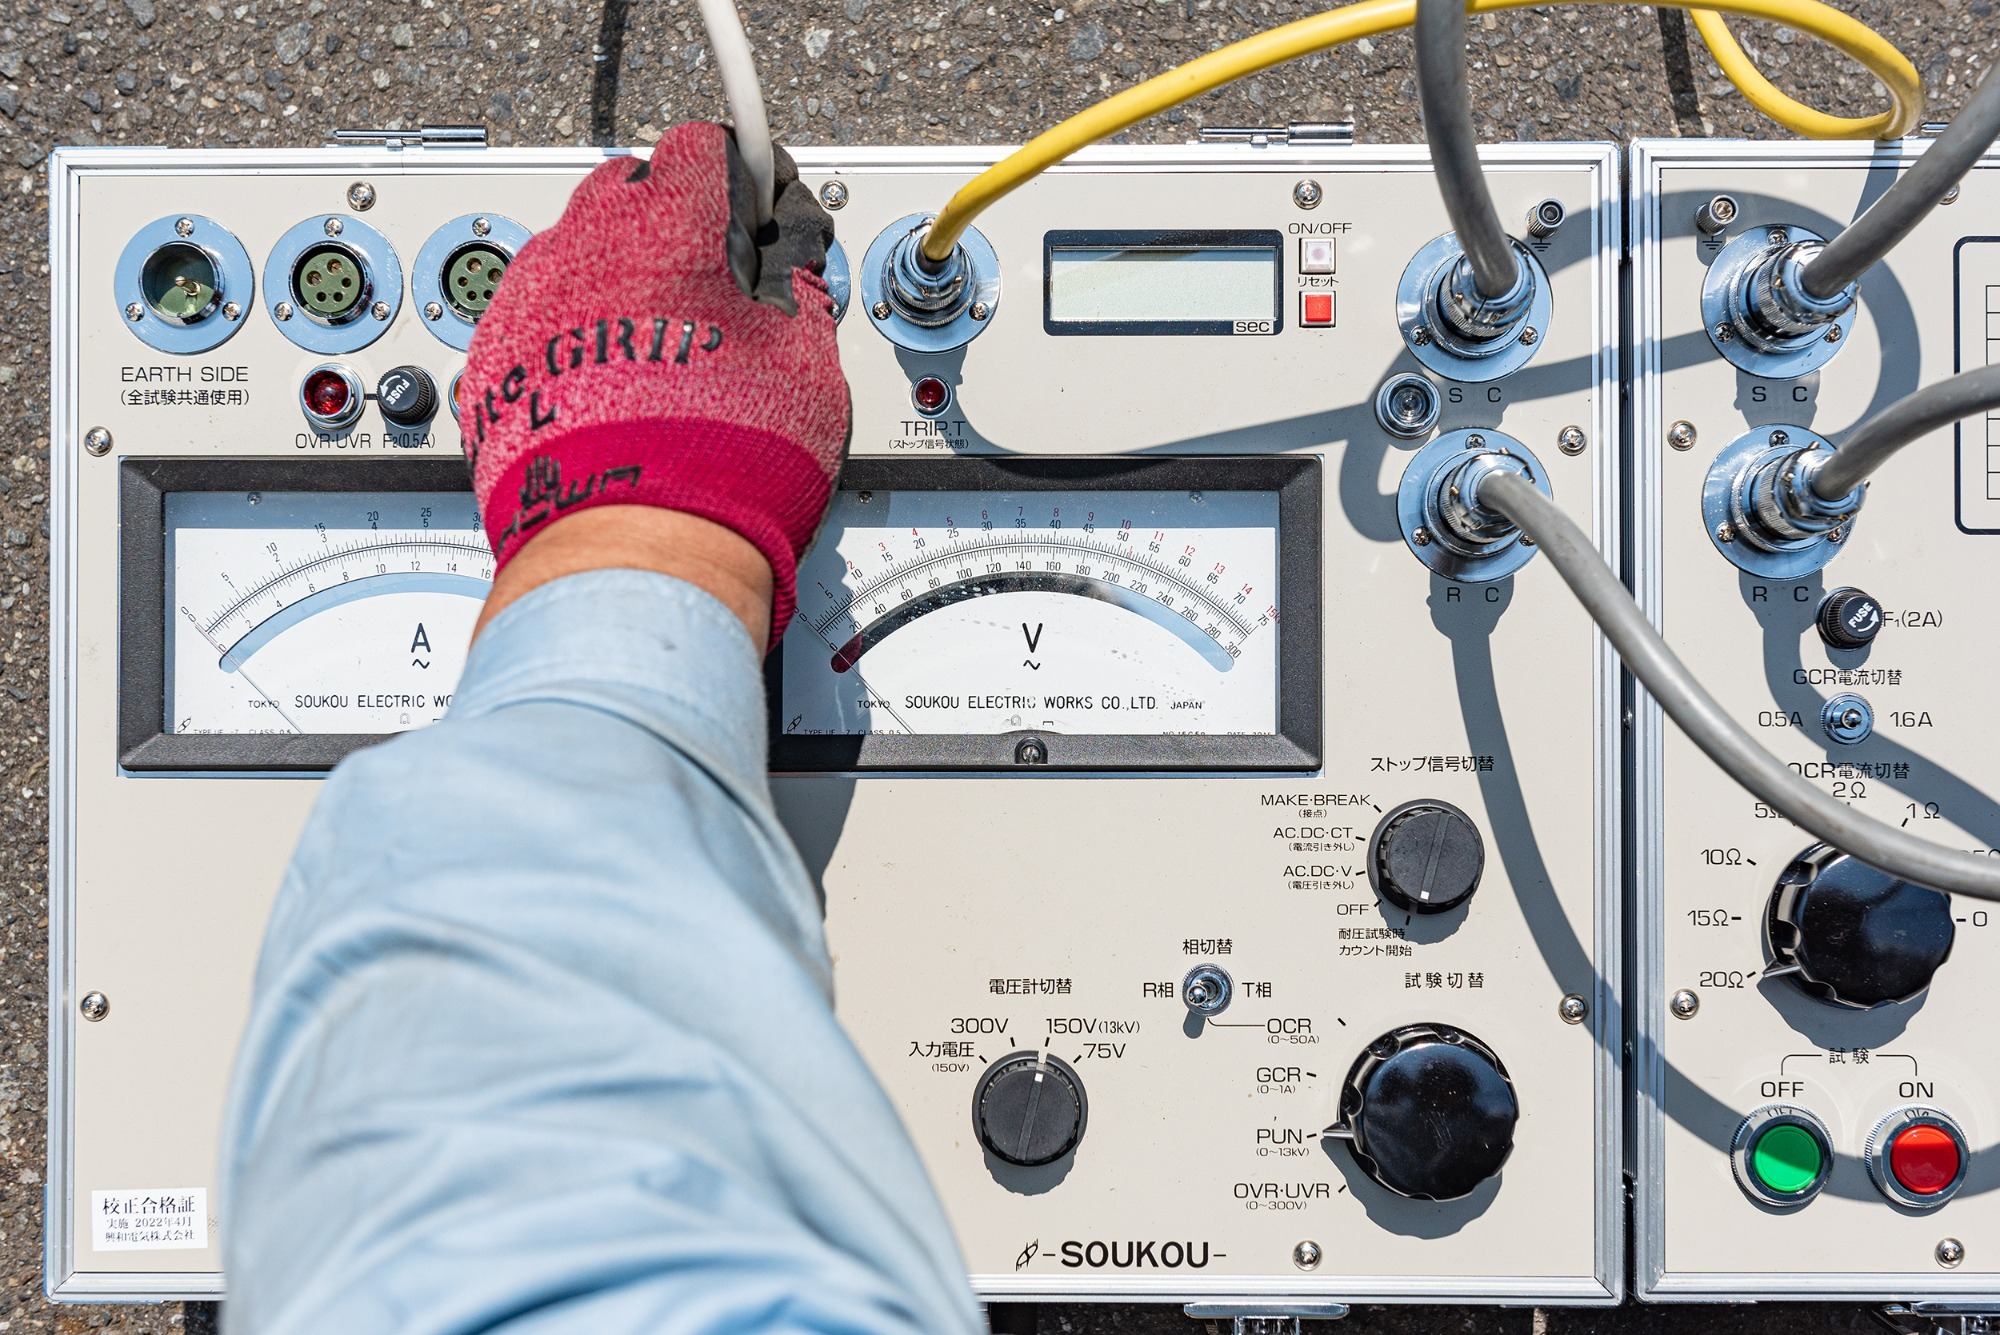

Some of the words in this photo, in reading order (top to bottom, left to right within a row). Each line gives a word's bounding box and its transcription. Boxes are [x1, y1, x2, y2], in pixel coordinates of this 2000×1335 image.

[1287, 222, 1352, 235] ON/OFF
[1297, 275, 1339, 287] リセット
[1235, 319, 1270, 333] sec
[546, 318, 724, 376] GRIP
[121, 367, 191, 382] EARTH
[201, 367, 248, 382] SIDE
[121, 389, 249, 406] (全試験共通使用)
[386, 378, 410, 405] FUSE
[530, 391, 556, 430] L
[901, 420, 966, 436] TRIP.T
[220, 572, 229, 582] 5
[266, 542, 277, 554] 10
[314, 522, 325, 533] 15
[366, 511, 379, 522] 20
[420, 507, 432, 518] 25
[274, 552, 280, 562] 2
[321, 533, 327, 542] 3
[371, 521, 378, 531] 4
[423, 518, 428, 527] 5
[473, 523, 479, 533] 6
[847, 560, 855, 570] 2
[878, 542, 886, 551] 3
[912, 528, 918, 537] 4
[947, 517, 953, 526] 5
[982, 510, 987, 520] 6
[1018, 507, 1023, 516] 7
[1053, 508, 1059, 517] 8
[1088, 512, 1094, 521] 9
[1121, 519, 1131, 530] 10
[1154, 530, 1164, 542] 11
[1184, 545, 1196, 557] 12
[1213, 562, 1226, 575] 13
[1241, 583, 1253, 595] 14
[825, 590, 833, 599] 5
[851, 569, 863, 580] 10
[881, 552, 893, 563] 15
[913, 538, 926, 549] 20
[947, 528, 959, 538] 25
[982, 521, 992, 531] 30
[1015, 519, 1026, 528] 35
[1050, 519, 1061, 529] 40
[1083, 523, 1094, 533] 45
[1117, 531, 1129, 541] 50
[1149, 541, 1160, 554] 55
[1178, 555, 1191, 568] 60
[1206, 572, 1219, 585] 65
[1233, 591, 1246, 604] 70
[1257, 613, 1270, 626] 75
[246, 620, 253, 629] 2
[276, 600, 282, 609] 4
[308, 583, 315, 593] 6
[342, 572, 349, 581] 8
[376, 563, 386, 573] 10
[411, 561, 420, 570] 12
[447, 562, 456, 572] 14
[481, 568, 491, 579] 16
[849, 621, 862, 633] 20
[874, 604, 887, 615] 40
[900, 589, 913, 600] 60
[928, 578, 941, 588] 80
[956, 568, 973, 580] 100
[986, 563, 1002, 573] 120
[1015, 561, 1032, 570] 140
[1045, 561, 1061, 571] 160
[1075, 564, 1091, 575] 180
[1102, 570, 1120, 584] 200
[1129, 579, 1148, 594] 220
[1156, 591, 1174, 607] 240
[1181, 606, 1199, 622] 260
[1204, 623, 1221, 639] 280
[1224, 642, 1241, 659] 300
[1847, 602, 1873, 629] FUSE
[411, 623, 431, 653] A
[1023, 623, 1043, 653] V
[1793, 668, 1903, 685] GCR電流切替
[248, 700, 279, 708] TOKYO
[295, 695, 348, 708] SOUKOU
[358, 695, 424, 708] ELECTRIC
[857, 700, 890, 709] TOKYO
[905, 695, 959, 709] SOUKOU
[968, 695, 1036, 709] ELECTRIC
[1044, 696, 1093, 709] WORKS
[1170, 701, 1202, 709] JAPAN
[1370, 756, 1495, 773] ストップ信号切替
[1700, 848, 1742, 865] 10Ω
[1337, 904, 1369, 915] OFF
[1687, 910, 1729, 927] 15Ω
[1972, 911, 1988, 928] 0
[1338, 928, 1405, 940] 耐圧試験時
[1183, 939, 1233, 955] 相切替
[1339, 945, 1412, 957] カウント開始
[989, 978, 1072, 995] 電圧計切替
[1699, 971, 1744, 989] 20Ω
[1143, 982, 1174, 998] R相
[1242, 981, 1272, 998] T相
[951, 1018, 1009, 1034] 300V
[1267, 1018, 1311, 1034] OCR
[909, 1041, 974, 1058] 入力電圧
[1083, 1043, 1126, 1059] 75V
[932, 1063, 970, 1072] (150V)
[1256, 1067, 1301, 1083] GCR
[1761, 1081, 1804, 1098] OFF
[1899, 1081, 1934, 1098] ON
[1257, 1128, 1302, 1144] PUN
[103, 1196, 195, 1215] 校正合格証
